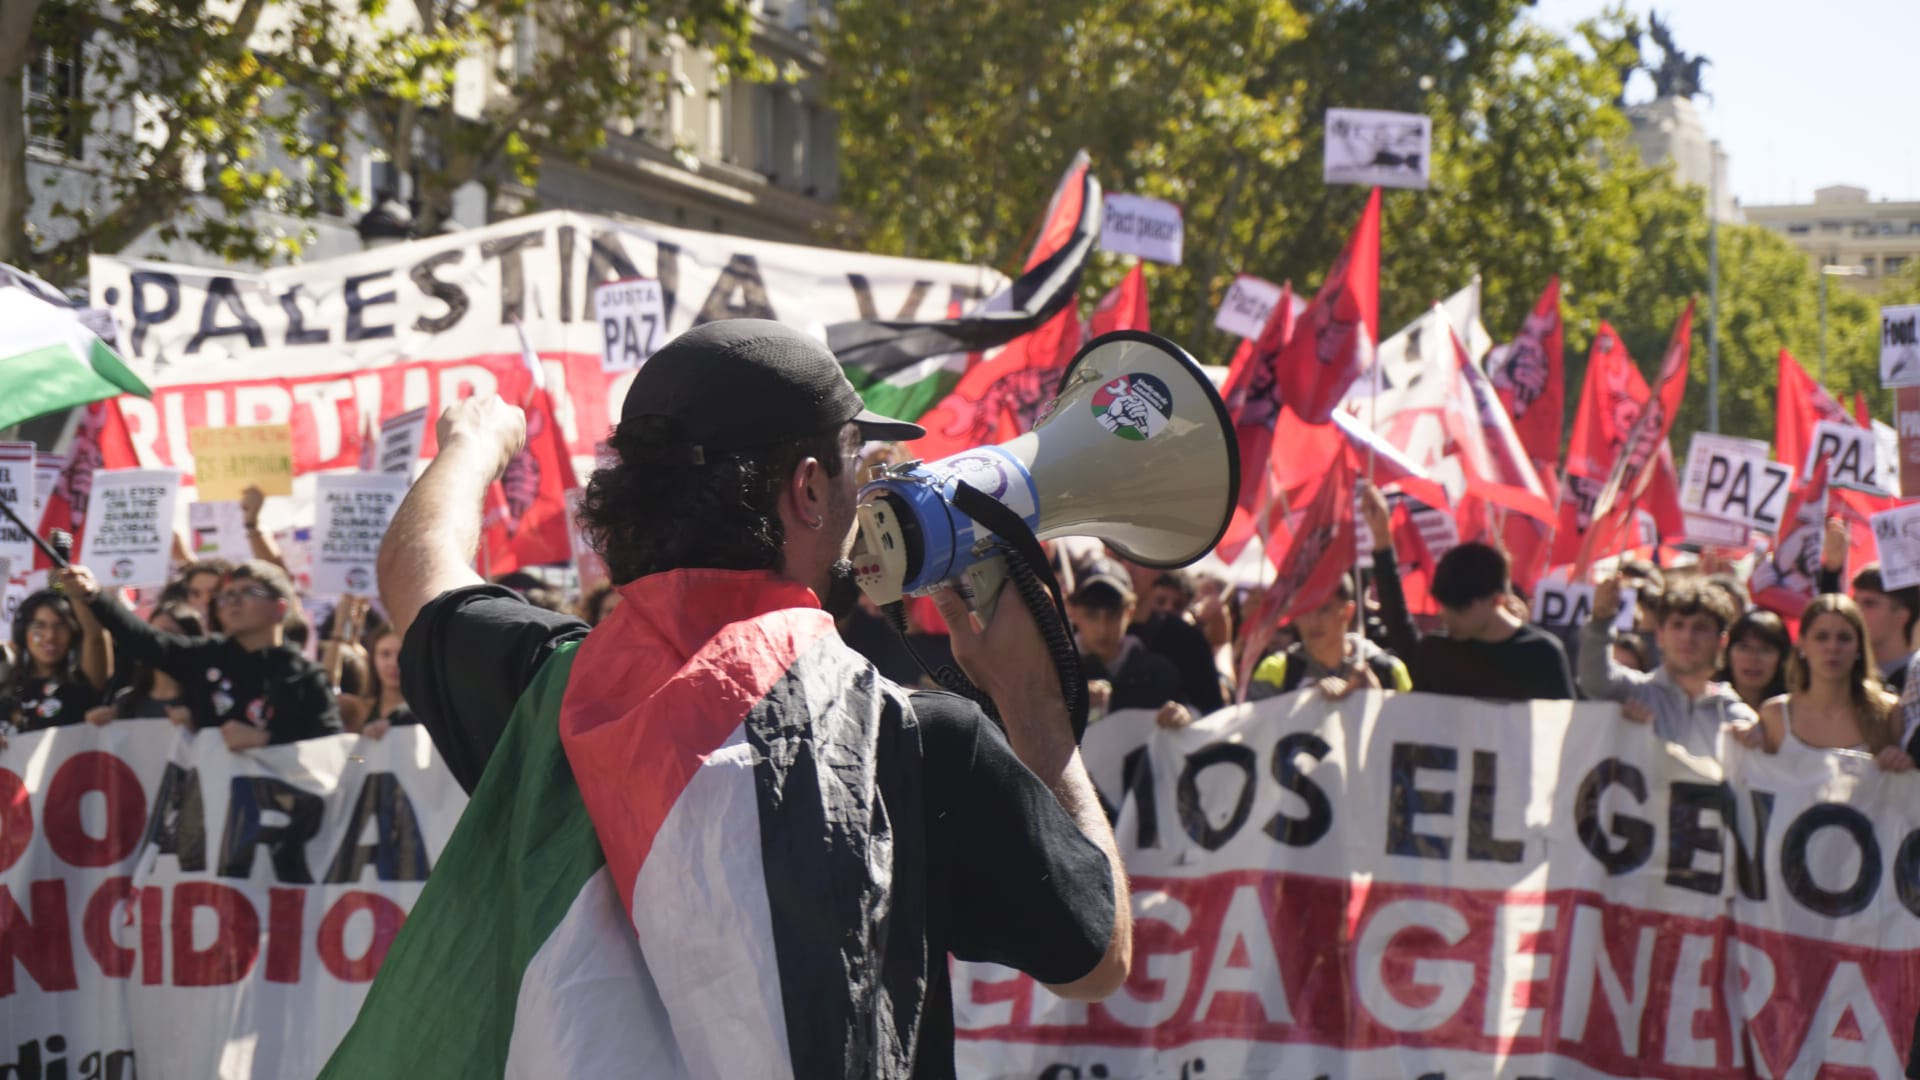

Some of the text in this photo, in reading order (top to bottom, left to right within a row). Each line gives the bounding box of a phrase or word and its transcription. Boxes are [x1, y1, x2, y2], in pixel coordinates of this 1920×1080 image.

[602, 288, 656, 307] JUSTA
[603, 314, 657, 362] PAZ
[1702, 454, 1788, 523] PAZ
[327, 531, 381, 539] GLOBA
[1386, 742, 1524, 863] EL
